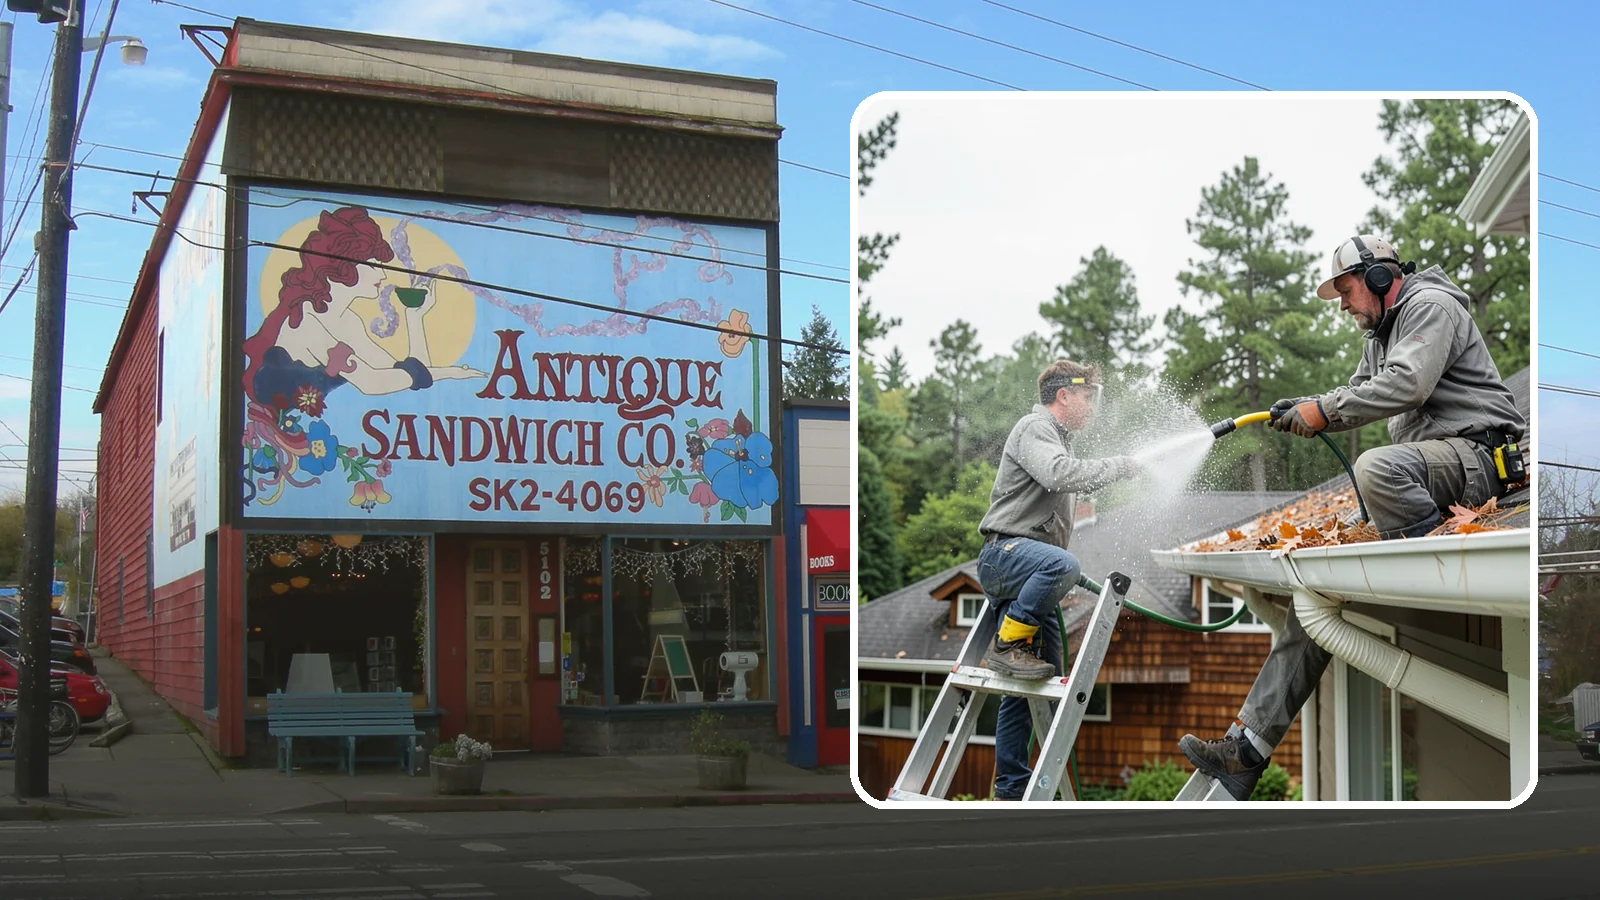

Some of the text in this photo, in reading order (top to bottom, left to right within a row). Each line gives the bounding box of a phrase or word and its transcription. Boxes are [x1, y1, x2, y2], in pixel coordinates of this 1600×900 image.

[476, 329, 723, 421] ANTIQUE
[361, 408, 685, 468] SANDWICH CO.
[468, 477, 645, 512] SK2-4069
[540, 542, 551, 600] 5102
[809, 555, 835, 569] BOOKS
